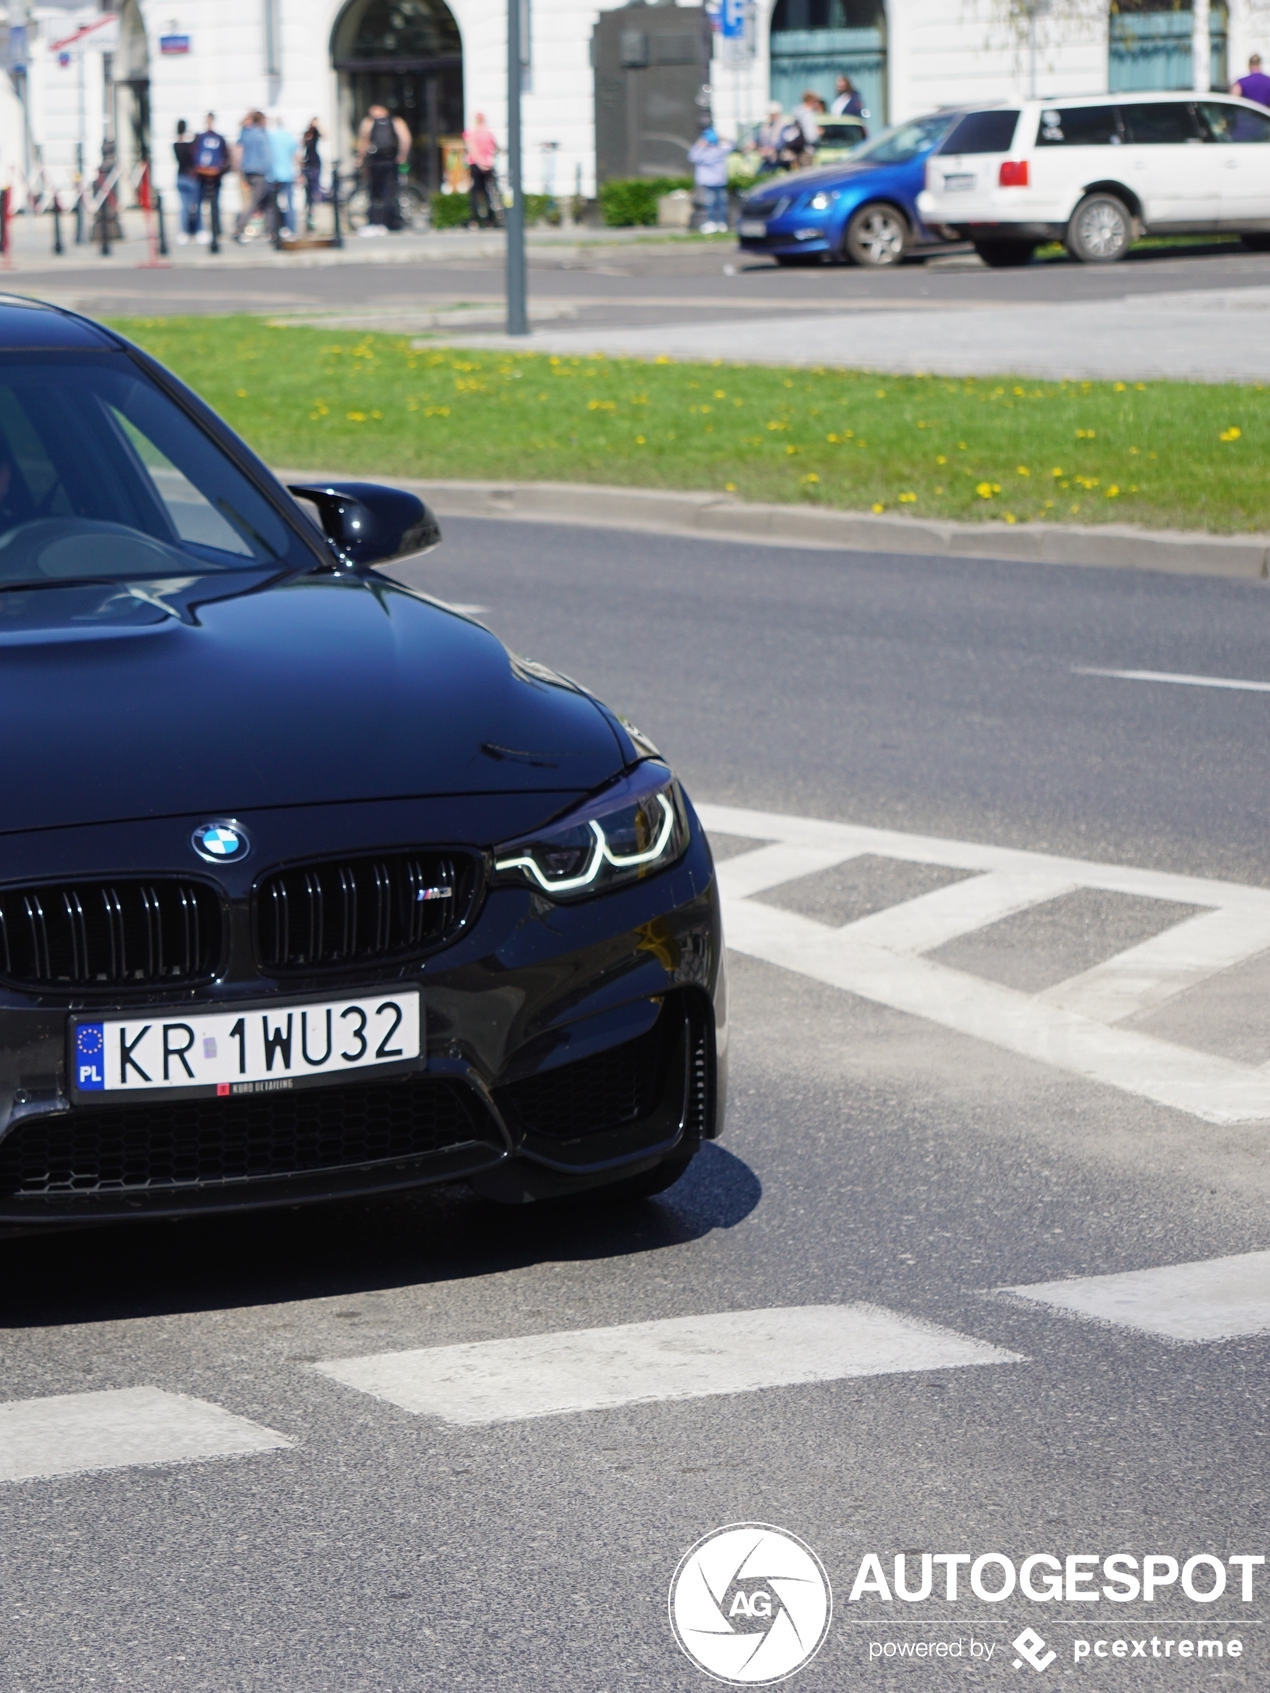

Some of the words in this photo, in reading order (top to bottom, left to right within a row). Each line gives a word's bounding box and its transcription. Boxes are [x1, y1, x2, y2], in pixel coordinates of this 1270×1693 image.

[120, 1022, 196, 1084] KR
[229, 1001, 403, 1074] 1WU32
[80, 1065, 102, 1083] PL
[255, 1079, 293, 1091] DETAILING
